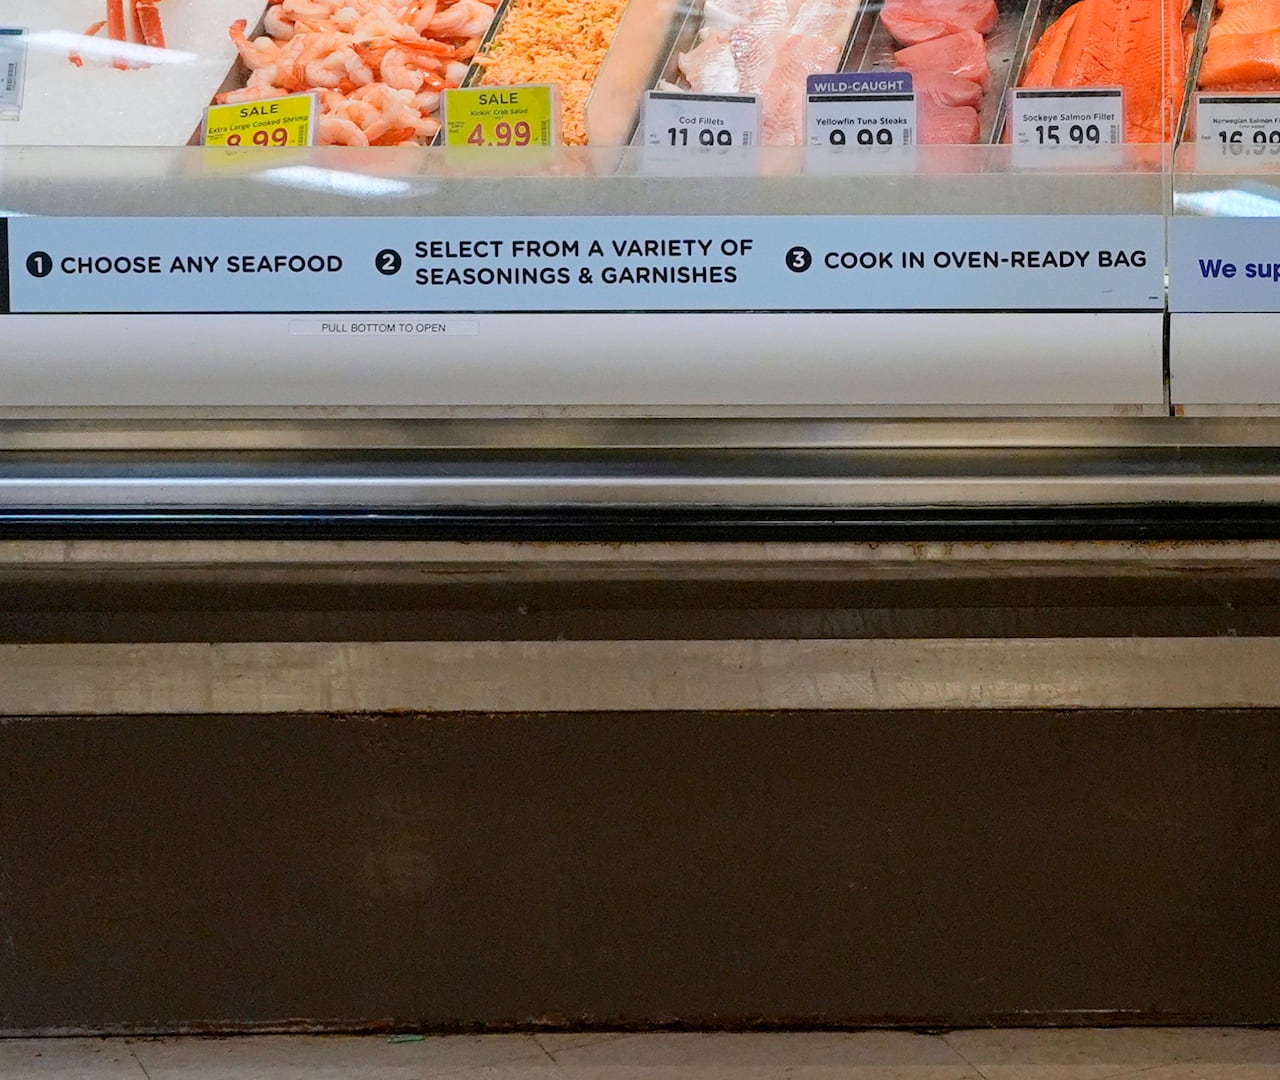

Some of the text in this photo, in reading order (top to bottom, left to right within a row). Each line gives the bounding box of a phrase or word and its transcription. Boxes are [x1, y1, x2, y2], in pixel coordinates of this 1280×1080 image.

[814, 80, 905, 93] WILD-CAUGHT
[478, 92, 519, 105] SALE
[239, 104, 279, 118] SALE
[1022, 113, 1115, 123] Sockeye Salmon Fillet
[208, 115, 309, 134] Extra Large Cooked Shrimp
[679, 116, 725, 126] Cod Fillets
[815, 116, 908, 126] Yellowfin Tuna Steaks
[1212, 117, 1248, 125] Norwegian
[226, 127, 289, 147] 899
[467, 121, 531, 147] 4.99
[667, 127, 733, 149] 1199
[829, 128, 893, 147] 999
[1035, 124, 1101, 145] 1599
[414, 240, 503, 258] SELECT
[512, 240, 579, 257] FROM
[588, 240, 604, 257] A
[612, 239, 713, 257] VARIETY
[720, 238, 754, 256] OF
[61, 256, 162, 273] CHOOSE
[169, 256, 220, 273] ANY
[226, 255, 344, 273] SEAFOOD
[824, 251, 894, 269] COOK
[902, 251, 925, 269] IN
[933, 250, 1091, 268] OVEN-READY
[1099, 250, 1148, 268] BAG
[1198, 258, 1237, 278] We
[415, 266, 738, 285] SEASONINGS & GARNISHES
[321, 323, 447, 333] PULL BOTTOM TO OPEN
